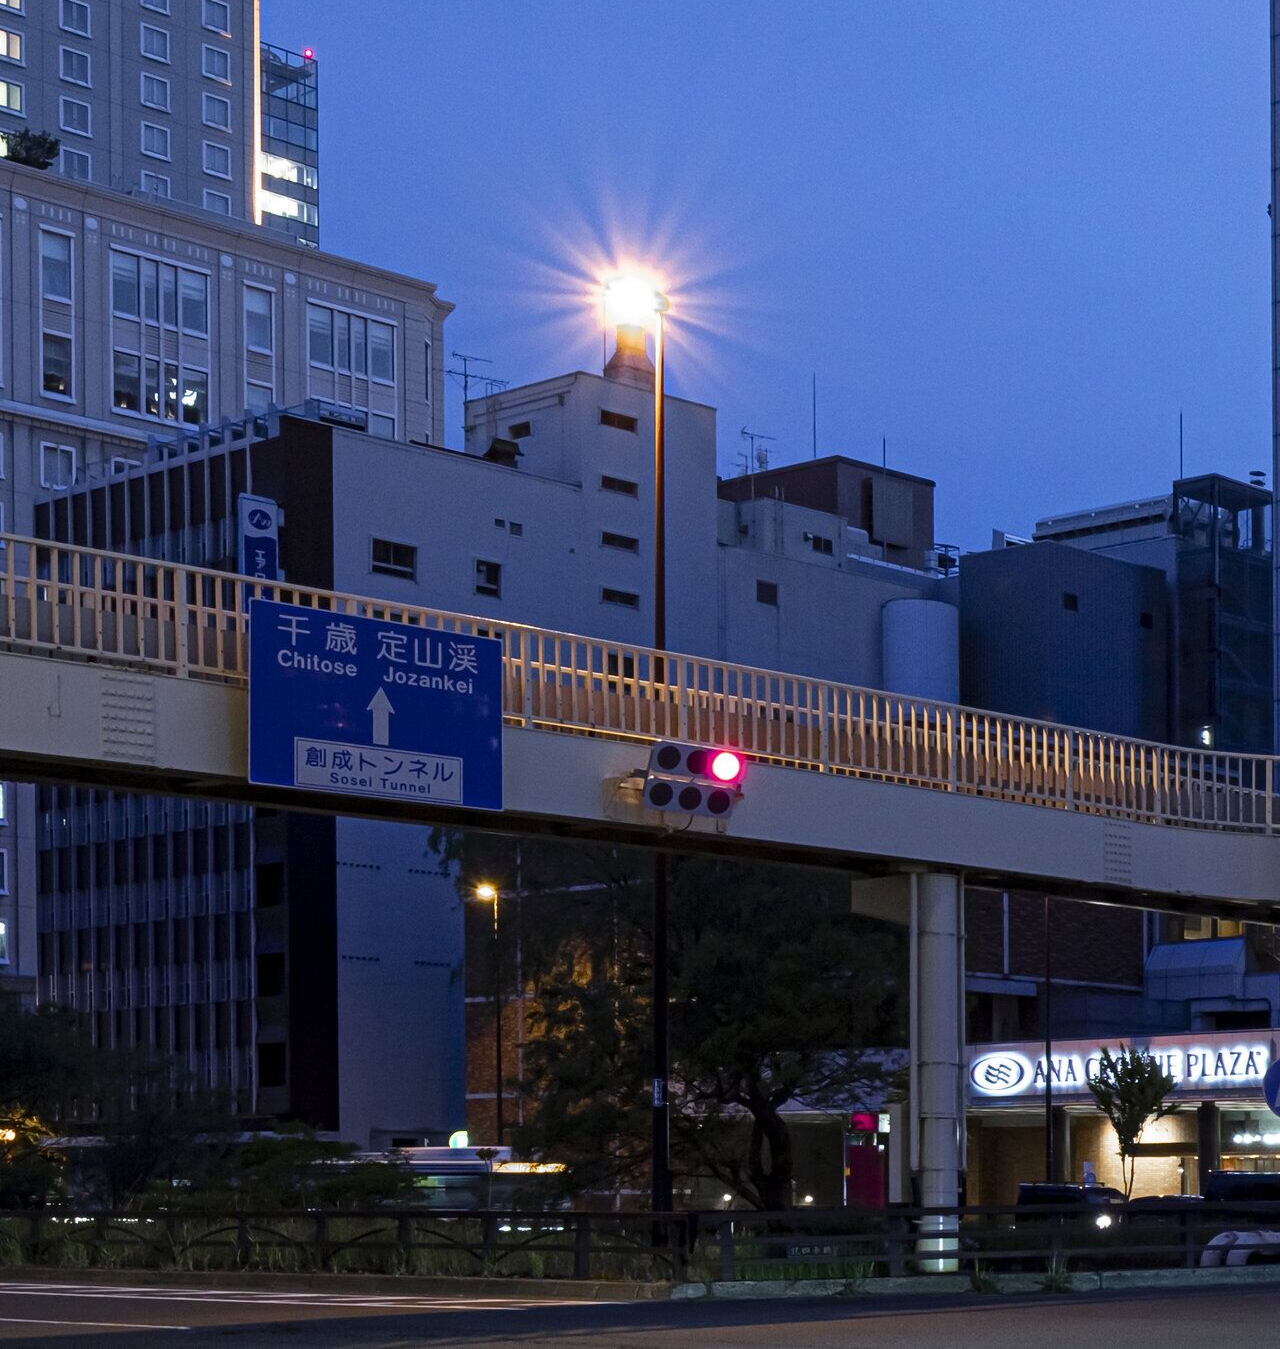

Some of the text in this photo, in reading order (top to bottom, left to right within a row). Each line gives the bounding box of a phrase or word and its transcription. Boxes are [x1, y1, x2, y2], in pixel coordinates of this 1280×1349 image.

[277, 614, 479, 675] 千歳 定山渓
[277, 649, 474, 695] Chitose Jozankei
[305, 746, 453, 782] 創成トンネル
[380, 778, 431, 794] Tunnel
[1033, 1059, 1078, 1084] ANA
[1186, 1050, 1261, 1078] PLAZA
